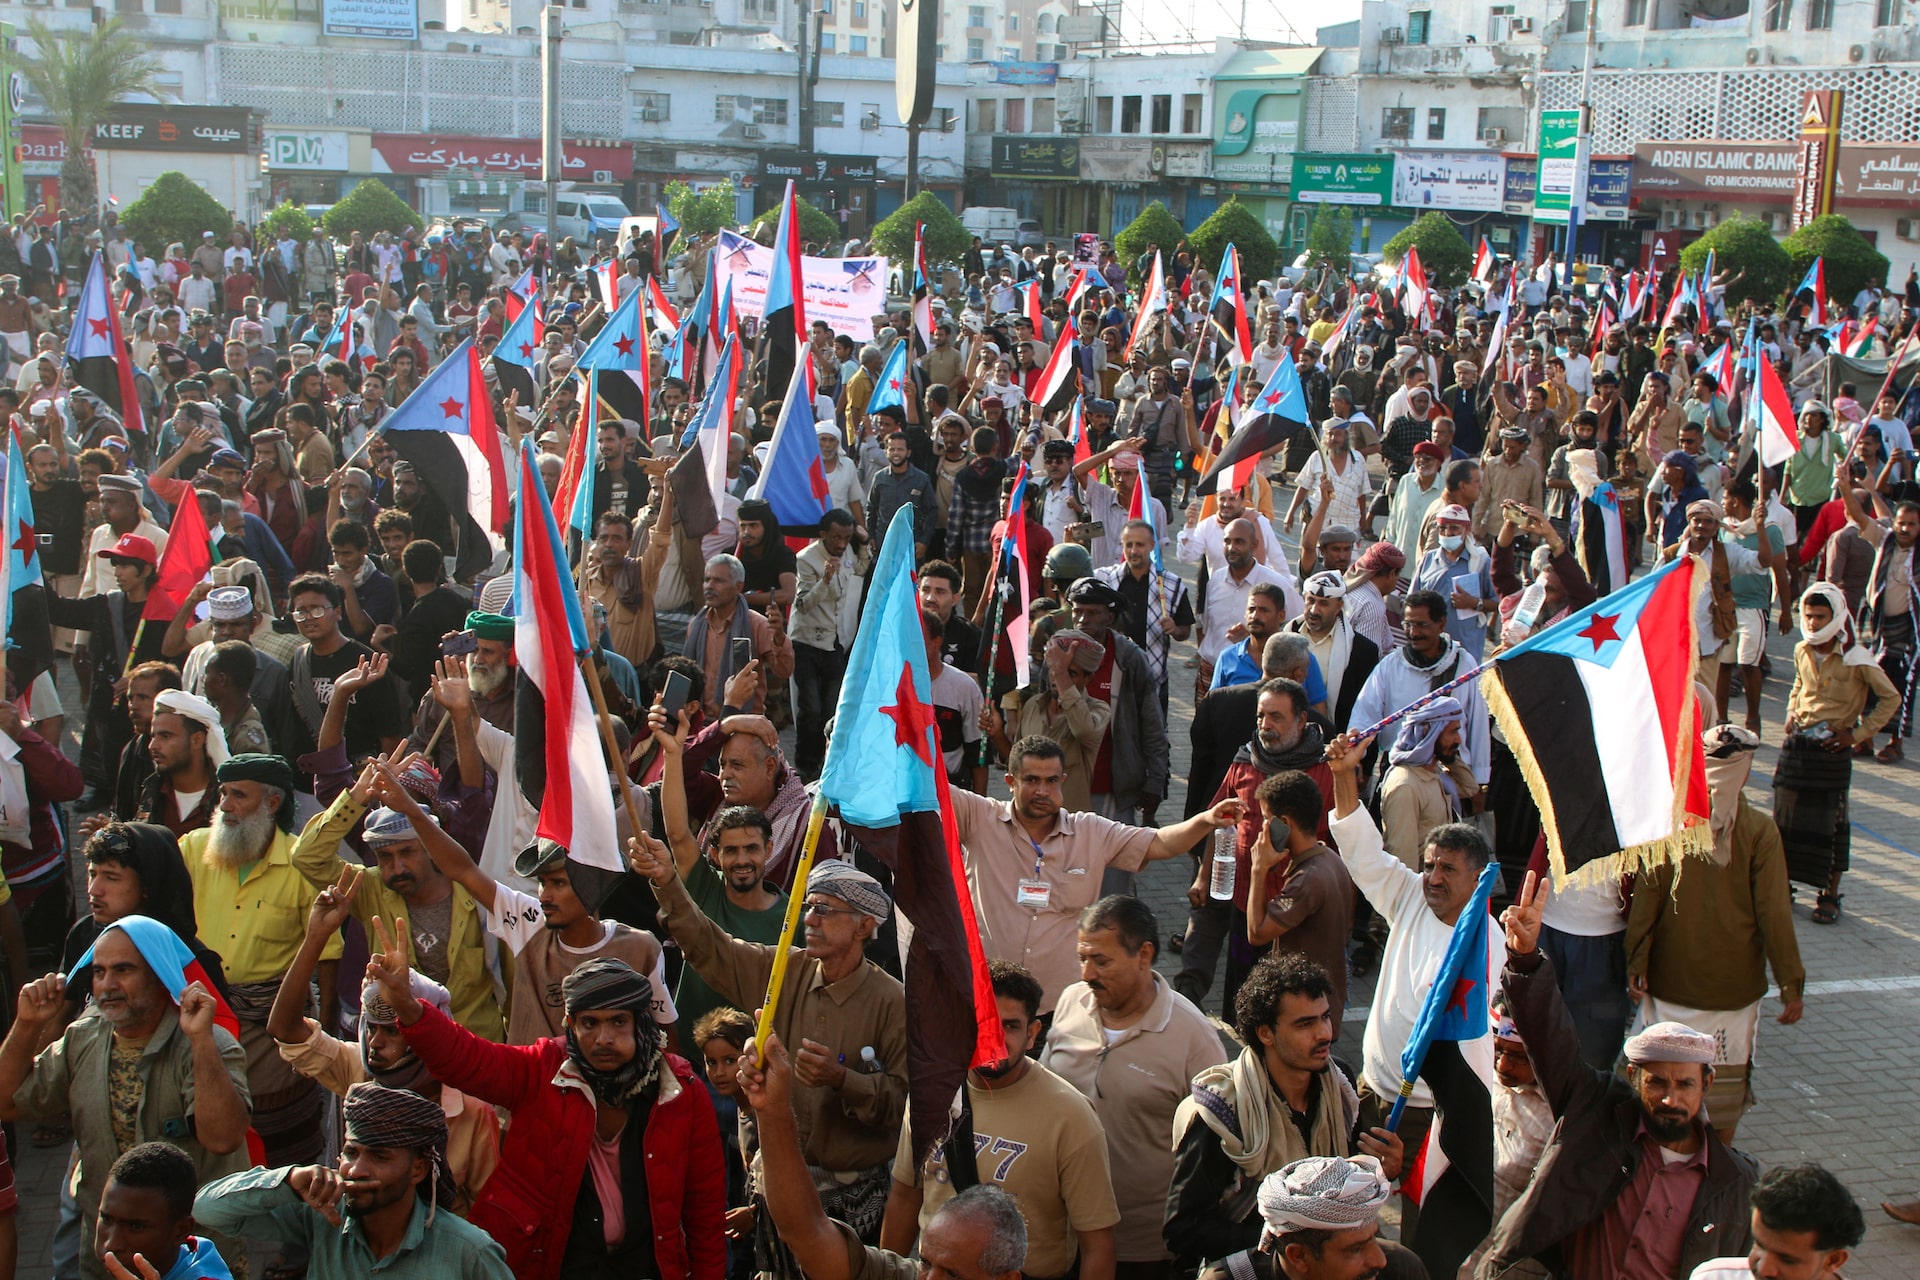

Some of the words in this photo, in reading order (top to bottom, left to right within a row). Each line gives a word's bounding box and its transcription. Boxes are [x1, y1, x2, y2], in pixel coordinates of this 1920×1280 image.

[96, 124, 144, 138] KEEF
[408, 150, 479, 168] ماركت
[484, 152, 543, 170] بارك
[1651, 150, 1692, 168] ADEN
[1694, 150, 1752, 170] ISLAMIC
[1754, 152, 1799, 171] BANK
[1808, 141, 1820, 178] BANK
[1860, 155, 1920, 178] سلامي
[766, 163, 802, 175] Shawarma
[844, 164, 874, 177] شاورما
[1305, 165, 1331, 174] FLYADEN
[1409, 166, 1452, 187] للتجارة
[1590, 164, 1629, 179] وكالة
[1456, 168, 1498, 192] باعبيد
[1705, 175, 1724, 186] FOR
[1726, 176, 1796, 189] MICROFINANCE
[1856, 178, 1904, 192] الأصغر
